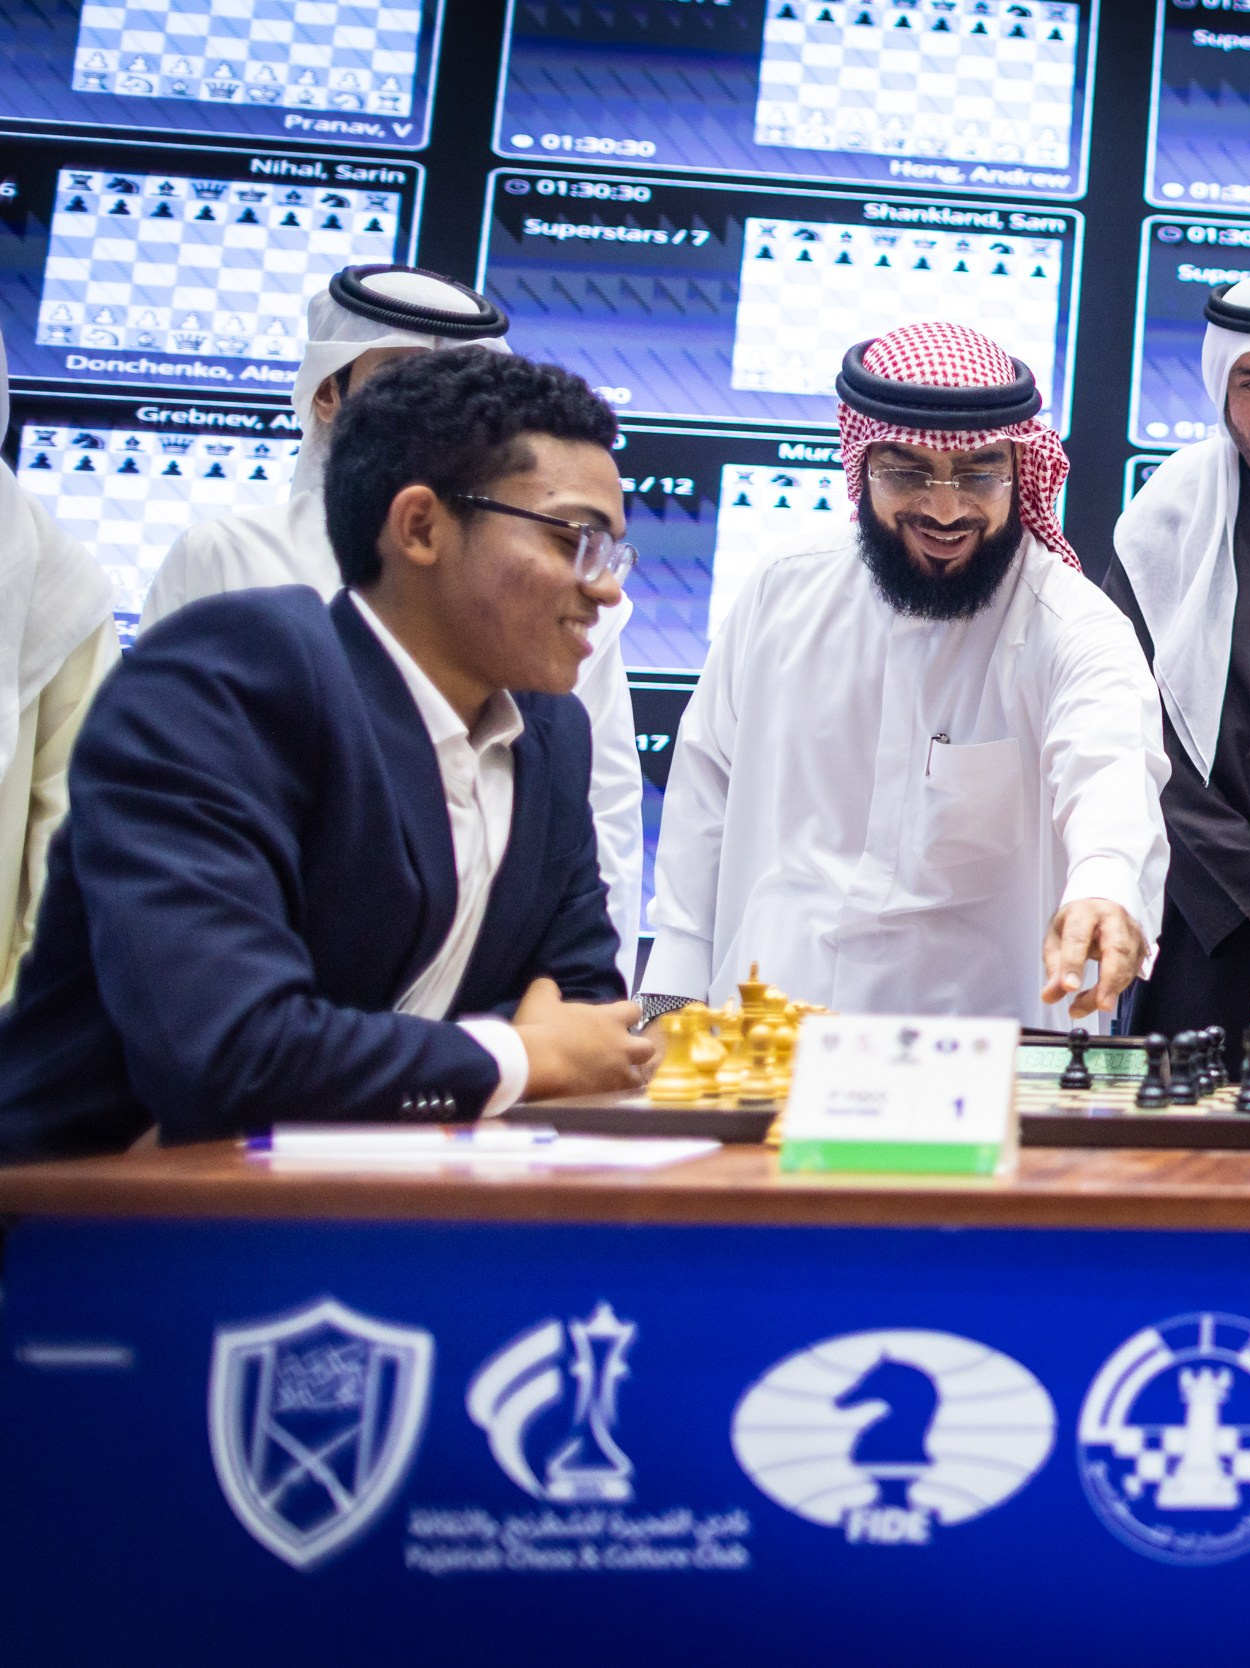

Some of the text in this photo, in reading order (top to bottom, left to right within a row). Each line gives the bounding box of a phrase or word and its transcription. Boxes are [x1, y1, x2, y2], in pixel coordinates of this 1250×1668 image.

[284, 114, 413, 138] Pranav, V
[540, 133, 656, 157] 01:30:30
[250, 158, 406, 184] Nihal, Sarin
[890, 159, 1071, 189] Hong, Andrew
[536, 179, 651, 202] 01:30:30
[863, 203, 1067, 233] Shankland, Sam
[524, 218, 669, 245] Superstars
[690, 230, 710, 247] 7
[65, 354, 234, 381] Donchenko,
[136, 406, 264, 430] Grebnev,
[659, 477, 695, 495] 12
[635, 733, 671, 752] 17
[952, 1096, 965, 1119] 1
[846, 1507, 928, 1545] FIDE
